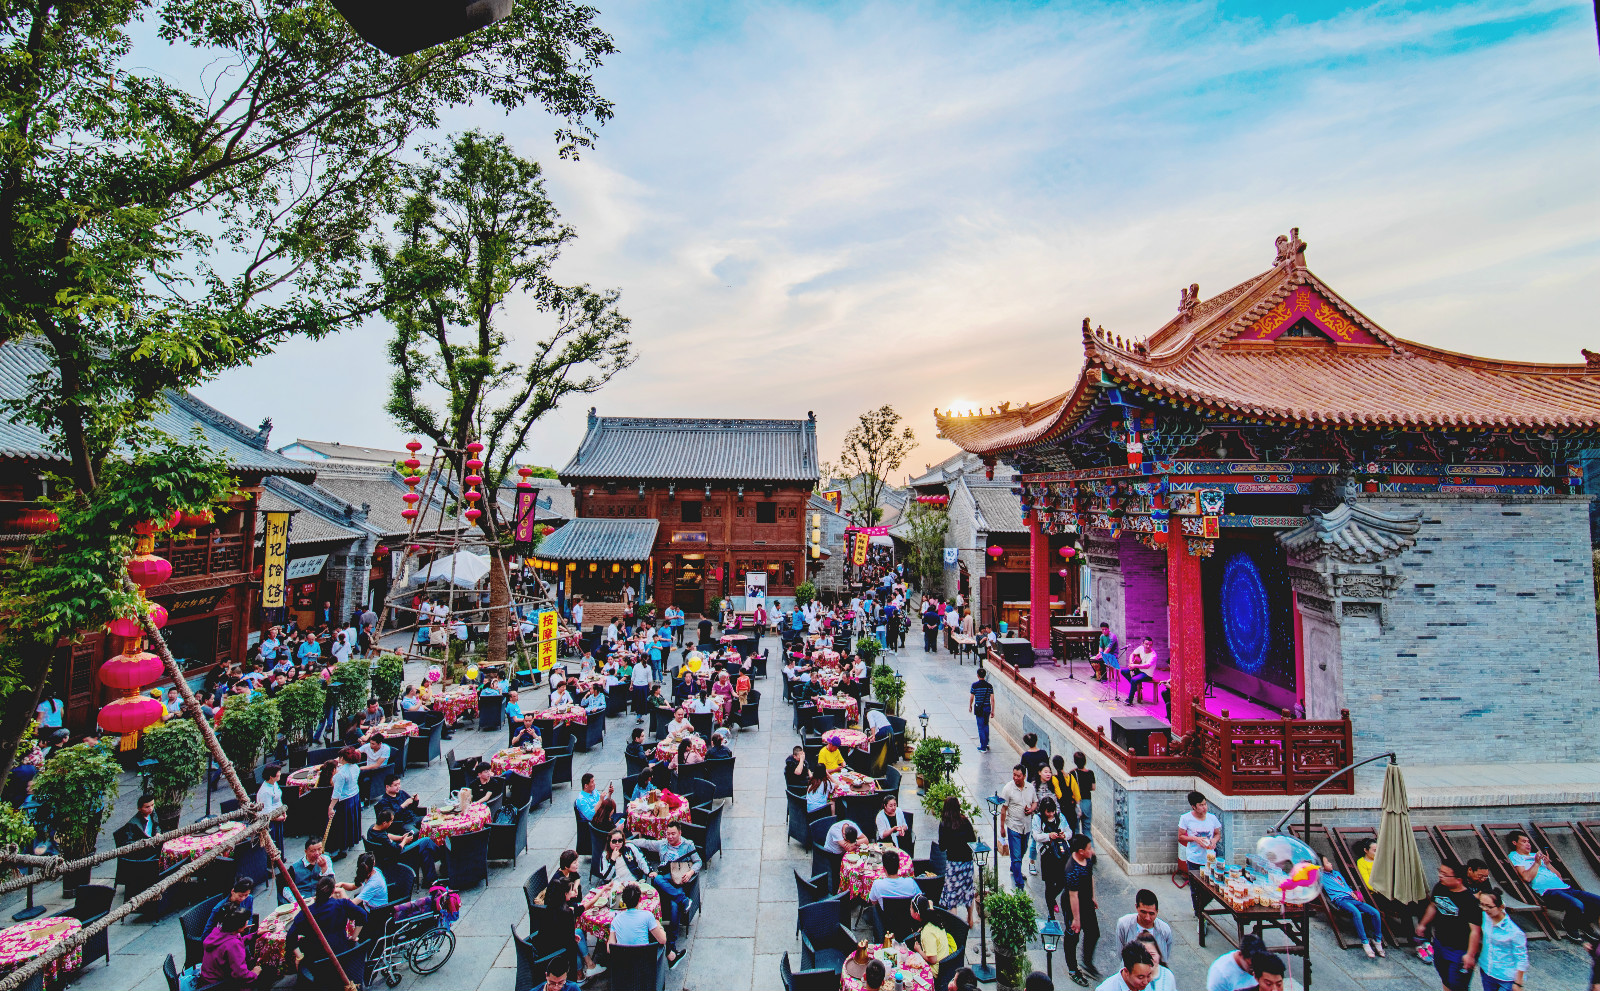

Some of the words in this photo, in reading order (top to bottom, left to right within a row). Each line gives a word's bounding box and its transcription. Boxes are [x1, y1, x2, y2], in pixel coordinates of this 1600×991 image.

[268, 520, 285, 597] 刘记饸饹
[541, 614, 554, 668] 按摩采耳
